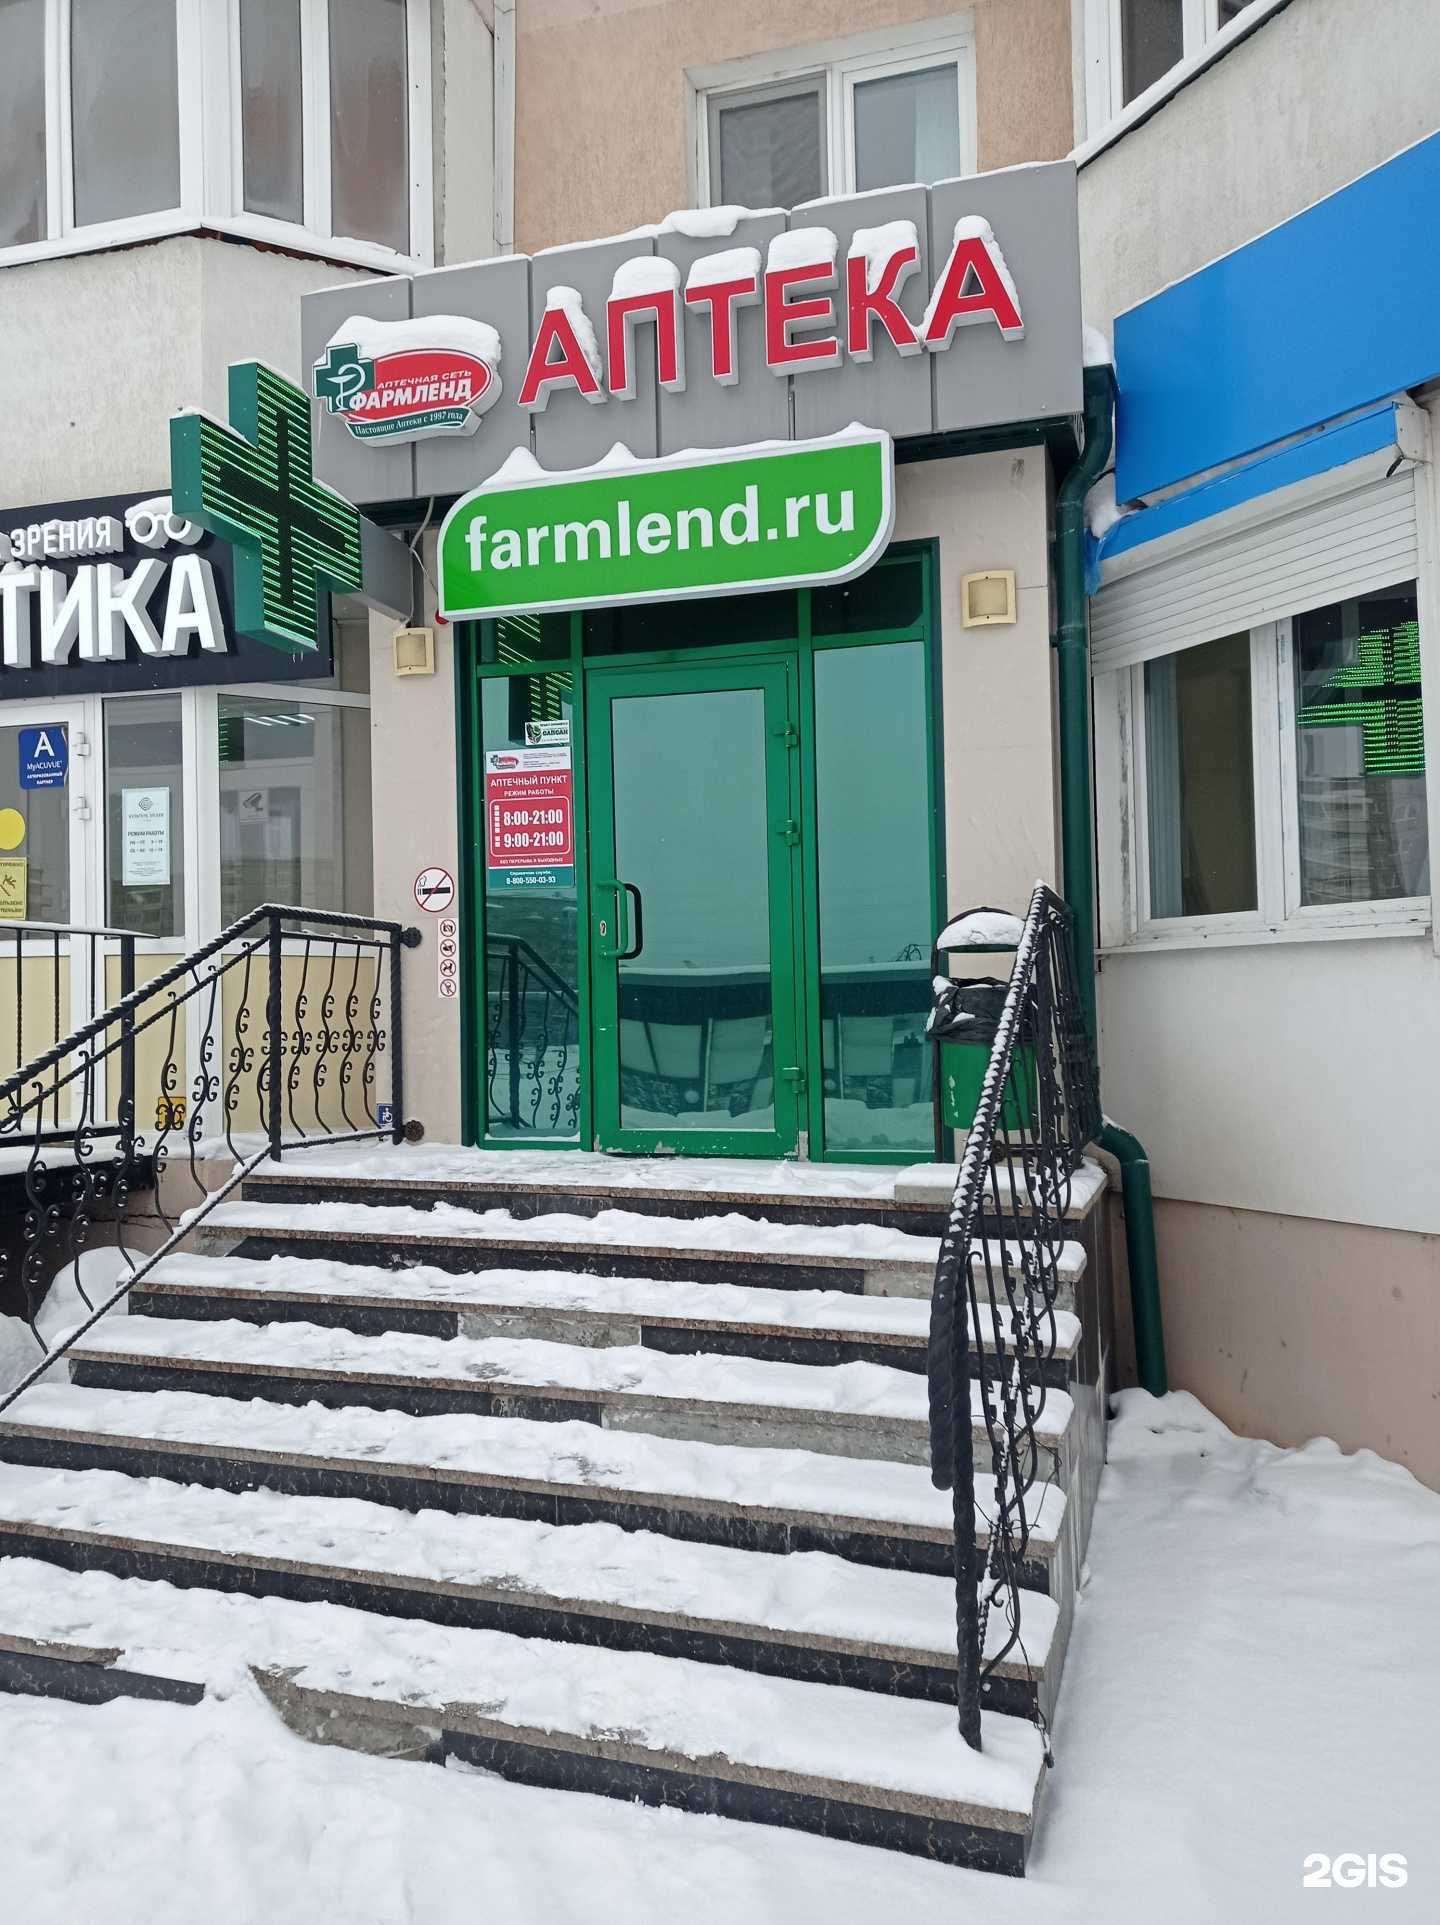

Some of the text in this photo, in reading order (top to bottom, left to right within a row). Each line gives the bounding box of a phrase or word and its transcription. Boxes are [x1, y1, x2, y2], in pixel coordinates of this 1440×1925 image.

[517, 235, 1024, 407] АПТЕКА
[377, 369, 472, 390] АПТЕЧНАЯ СЕТЬ
[350, 378, 472, 411] ФАРМЛЕНД
[395, 417, 422, 430] Аптеки
[430, 411, 446, 422] 1997
[10, 517, 113, 558] ЗРЕНИЯ
[465, 484, 855, 572] farmlend.ru
[490, 775, 568, 787] АПТЕЧНЫЙ ПУНКТ
[503, 788, 554, 797] РЕЖИМ РАБОТЫ
[503, 809, 563, 826] 8:00-21:00
[503, 831, 564, 848] 9:00-21:00
